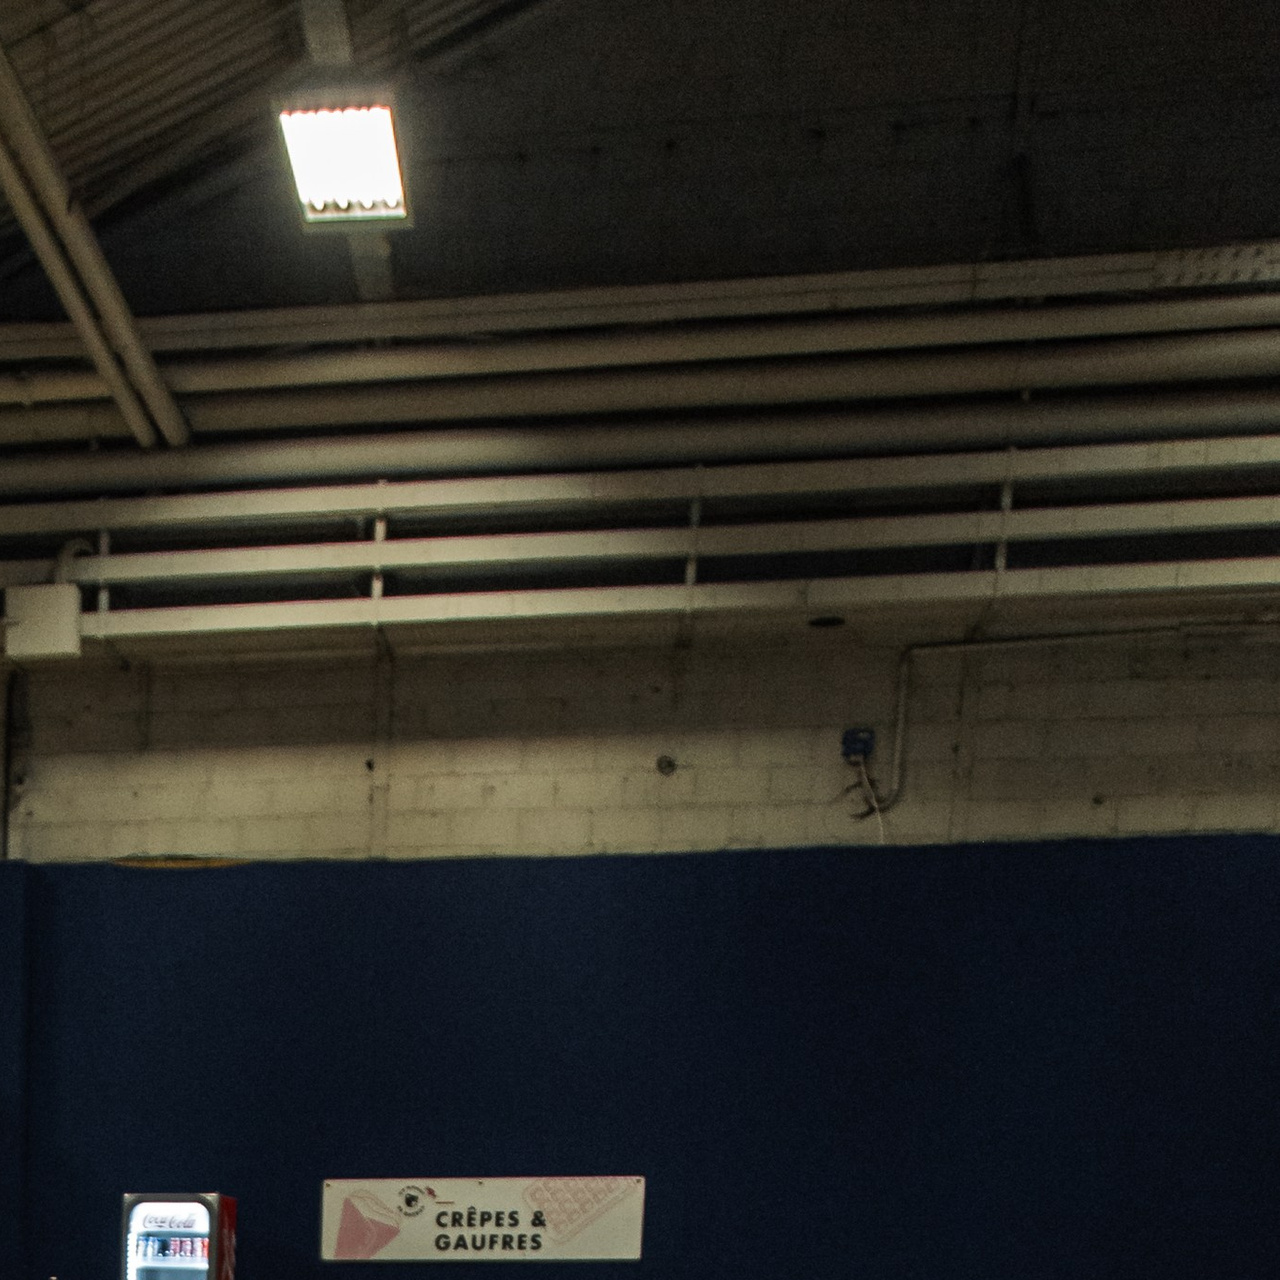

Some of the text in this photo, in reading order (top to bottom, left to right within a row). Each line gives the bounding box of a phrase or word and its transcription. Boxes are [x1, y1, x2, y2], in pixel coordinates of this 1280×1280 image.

[435, 1206, 521, 1228] CRÊPES
[531, 1210, 548, 1228] &
[434, 1233, 543, 1251] GAUFRES
